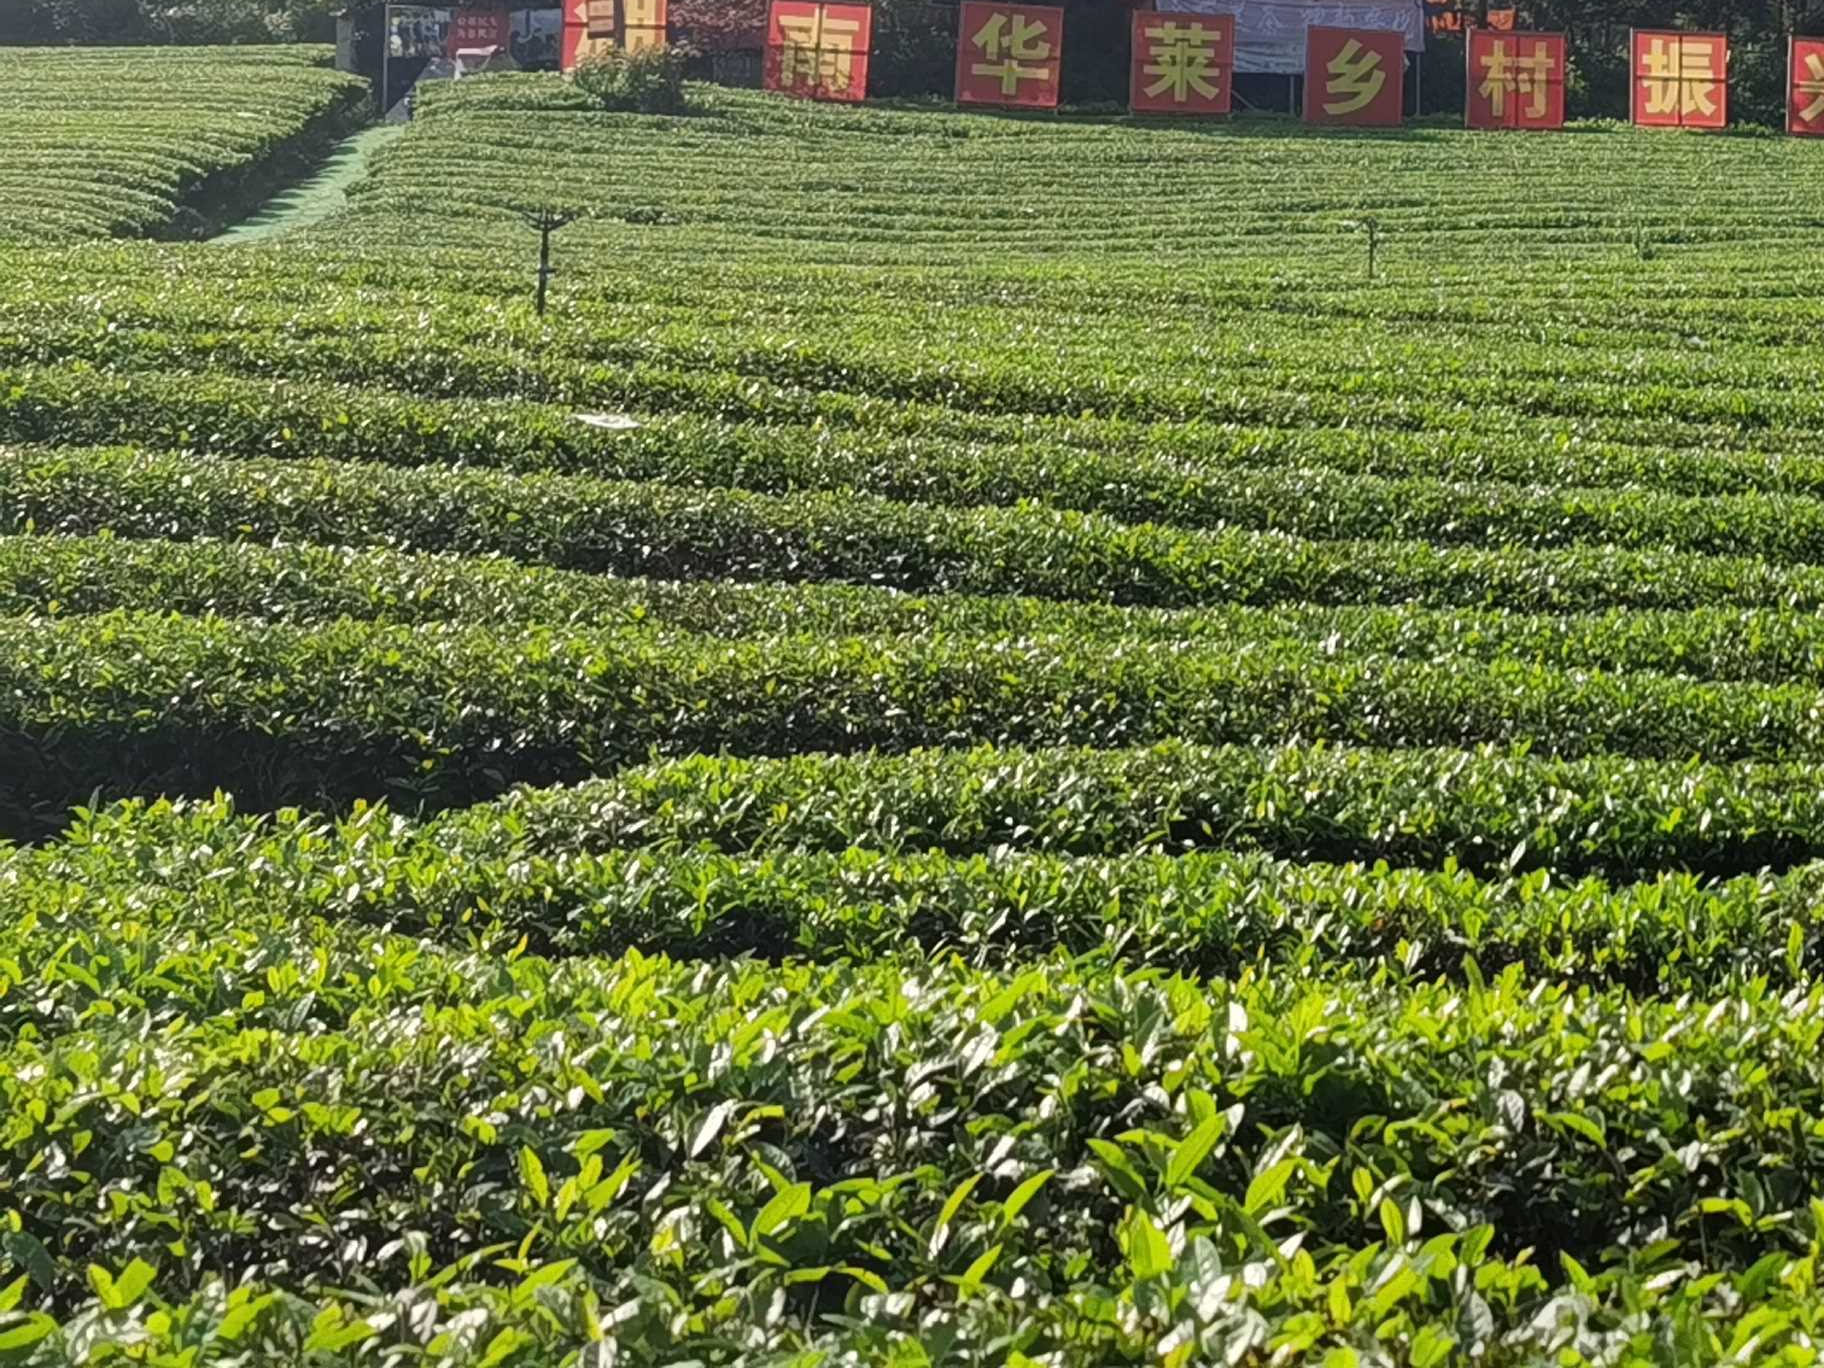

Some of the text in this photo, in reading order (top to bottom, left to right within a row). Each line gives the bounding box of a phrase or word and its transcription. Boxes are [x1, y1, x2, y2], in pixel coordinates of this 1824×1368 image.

[779, 6, 860, 89] 南
[971, 13, 1051, 95] 华
[1143, 21, 1221, 102] 莱
[1322, 38, 1387, 116] 乡
[1478, 40, 1554, 120] 村
[1642, 39, 1717, 117] 振
